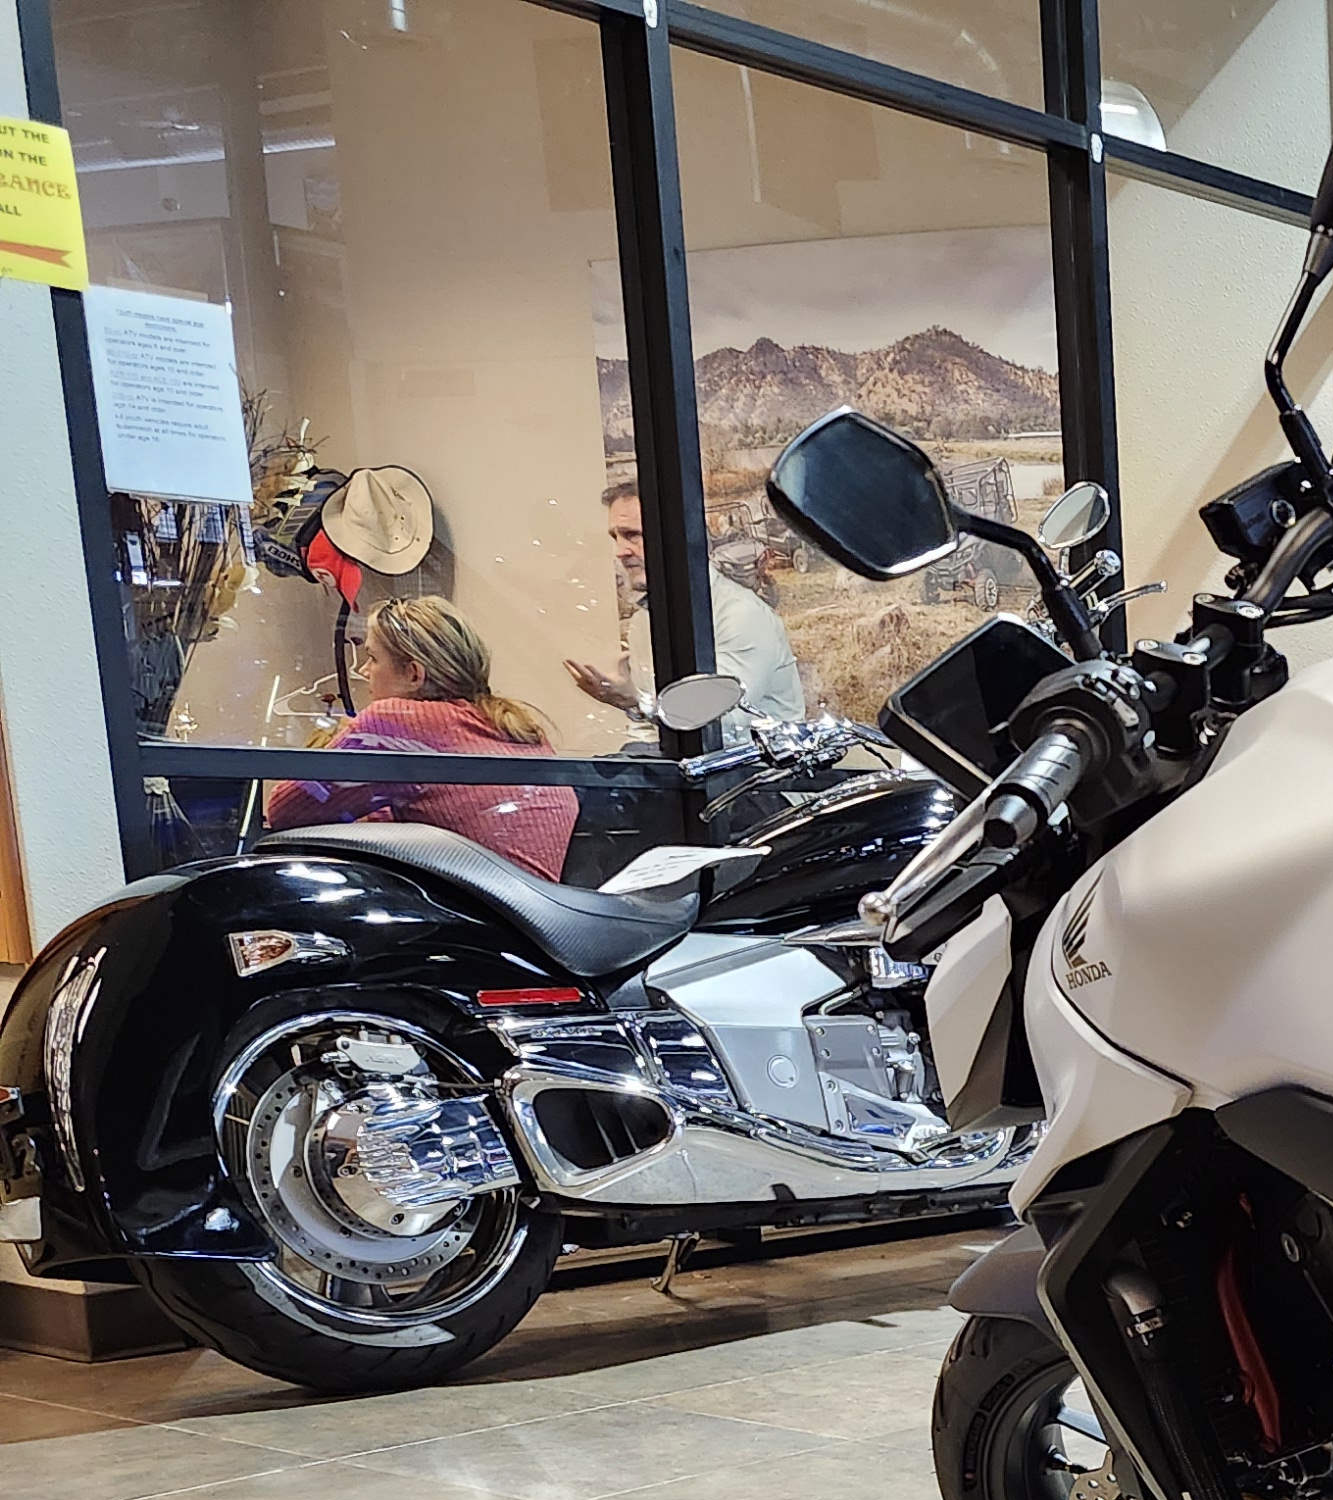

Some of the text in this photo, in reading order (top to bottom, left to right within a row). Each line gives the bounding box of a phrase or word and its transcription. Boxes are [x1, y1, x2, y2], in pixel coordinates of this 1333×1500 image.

[21, 128, 50, 144] THE
[19, 152, 47, 167] THE
[1065, 961, 1113, 990] HONDA
